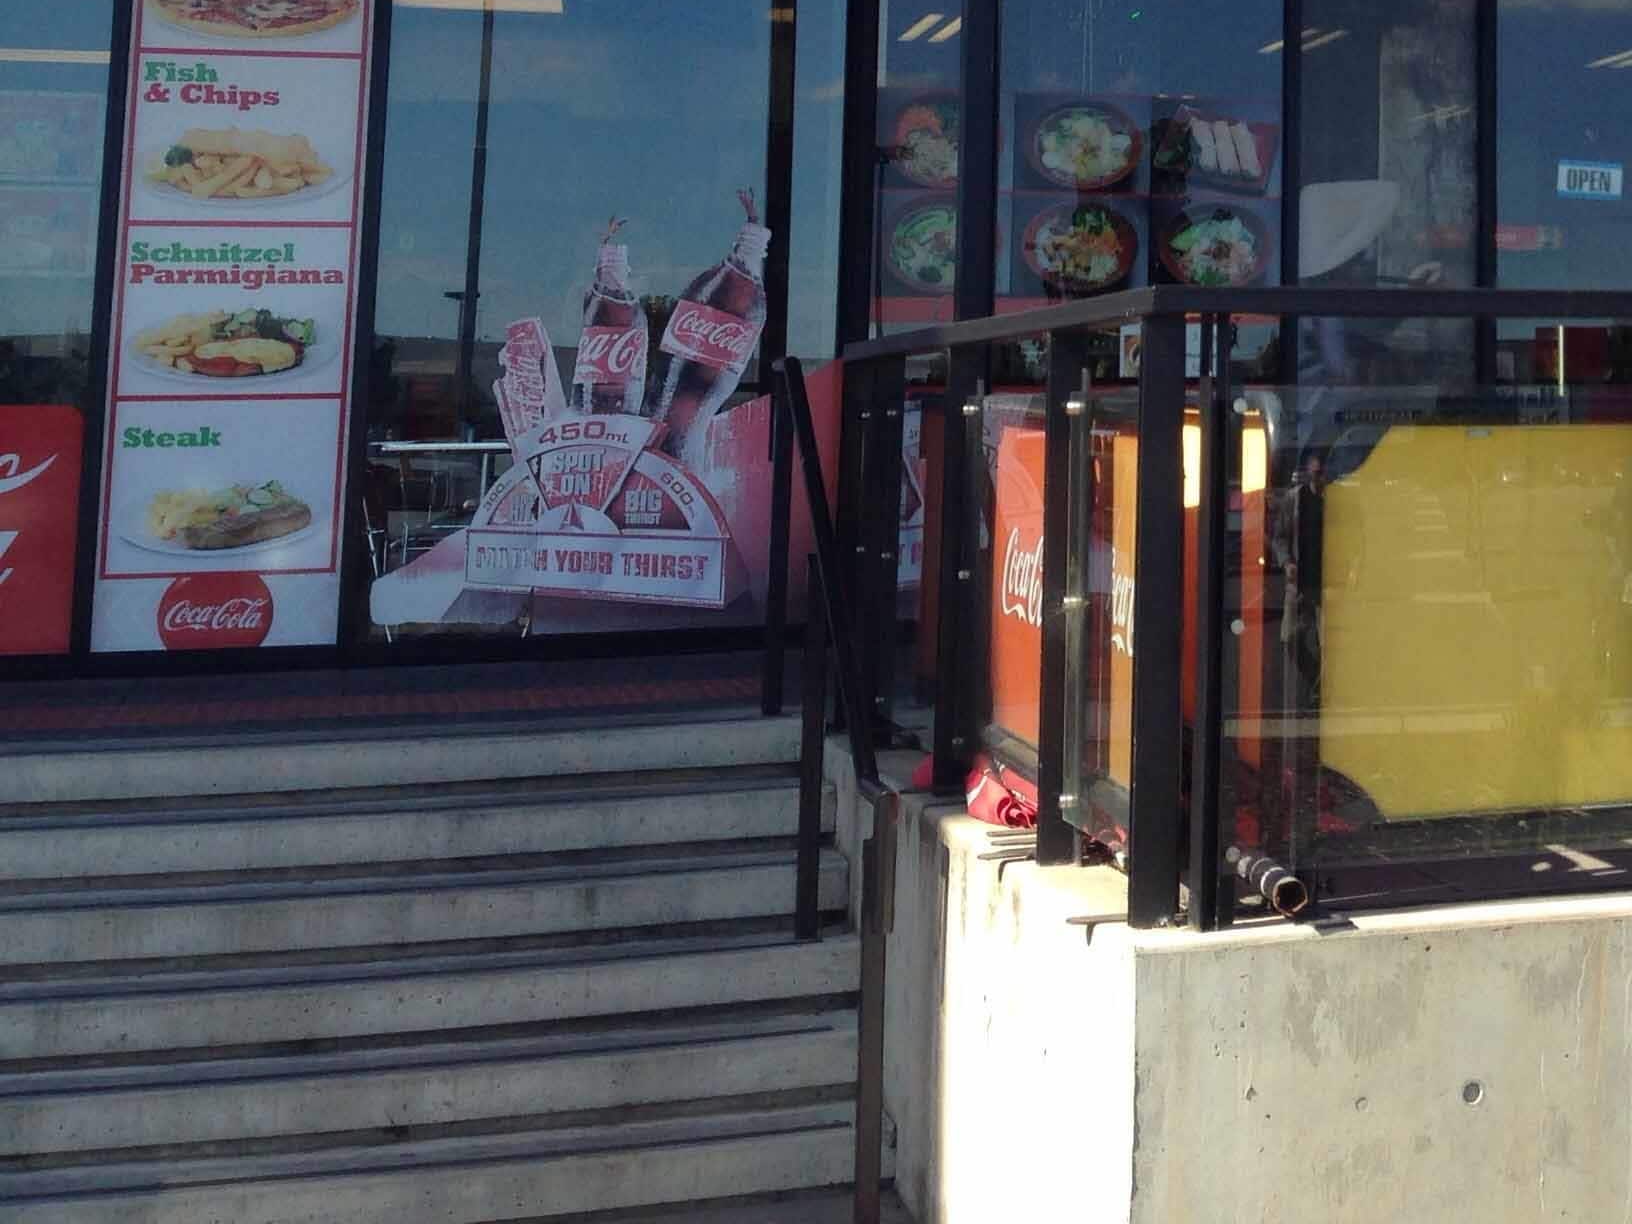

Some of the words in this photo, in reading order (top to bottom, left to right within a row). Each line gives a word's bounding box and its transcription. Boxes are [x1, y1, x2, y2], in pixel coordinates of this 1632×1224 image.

[143, 60, 219, 83] Fish
[143, 83, 170, 104] &
[179, 83, 281, 111] Chips
[1566, 168, 1611, 193] OPEN
[130, 241, 297, 263] Schnitzel
[128, 263, 345, 290] Parmigiana
[122, 426, 221, 449] Steak
[560, 474, 592, 496] ON
[624, 488, 663, 513] BIG
[553, 550, 613, 575] YOUR
[620, 553, 710, 580] THIRST
[164, 598, 270, 631] Coca-Cola
